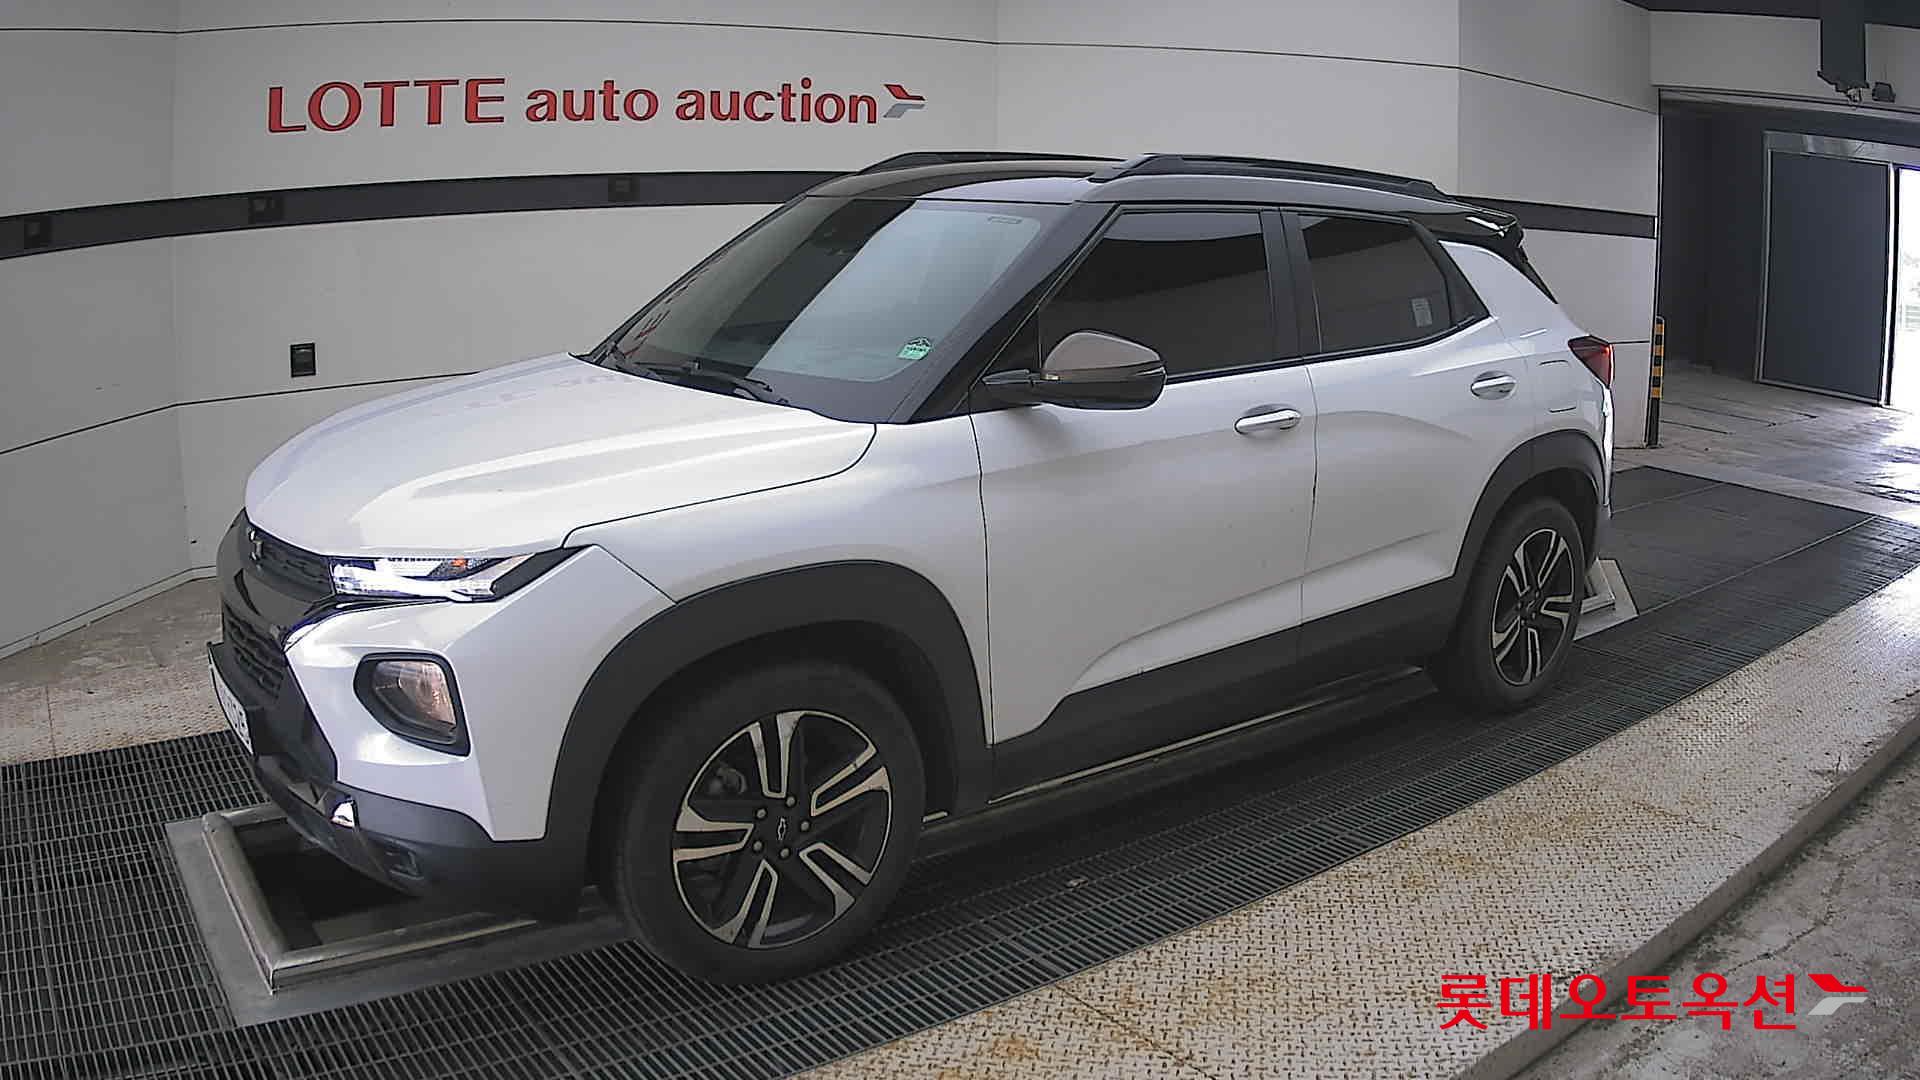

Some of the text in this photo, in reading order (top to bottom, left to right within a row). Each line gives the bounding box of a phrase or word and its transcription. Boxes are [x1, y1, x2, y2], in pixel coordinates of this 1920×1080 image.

[268, 77, 878, 133] LOTTE auto auction
